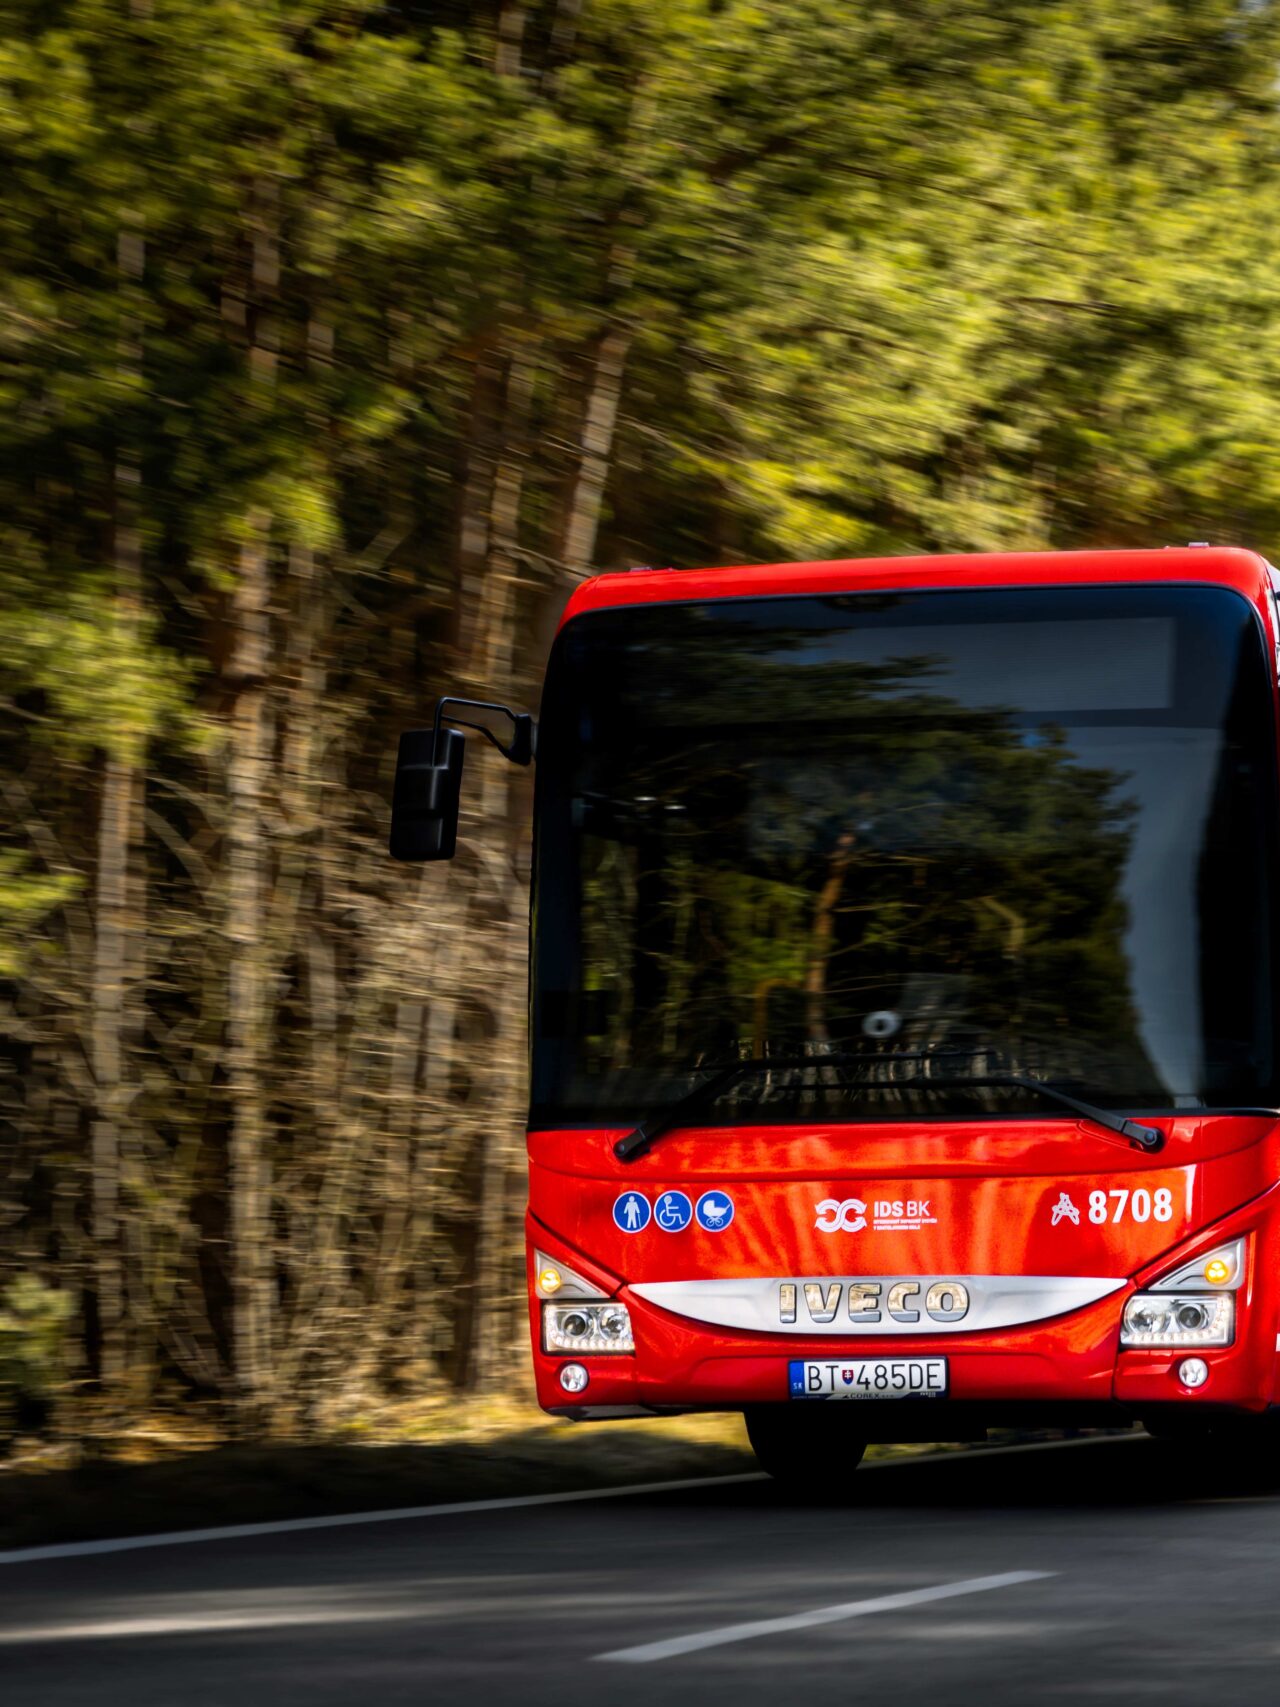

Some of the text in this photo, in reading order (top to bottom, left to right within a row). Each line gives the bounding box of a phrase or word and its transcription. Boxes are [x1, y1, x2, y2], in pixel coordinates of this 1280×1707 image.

[874, 1200, 931, 1217] IDS BK
[1088, 1188, 1173, 1225] 8708
[779, 1282, 971, 1324] IVECO
[792, 1382, 804, 1391] SK
[807, 1363, 942, 1391] BT 485DE
